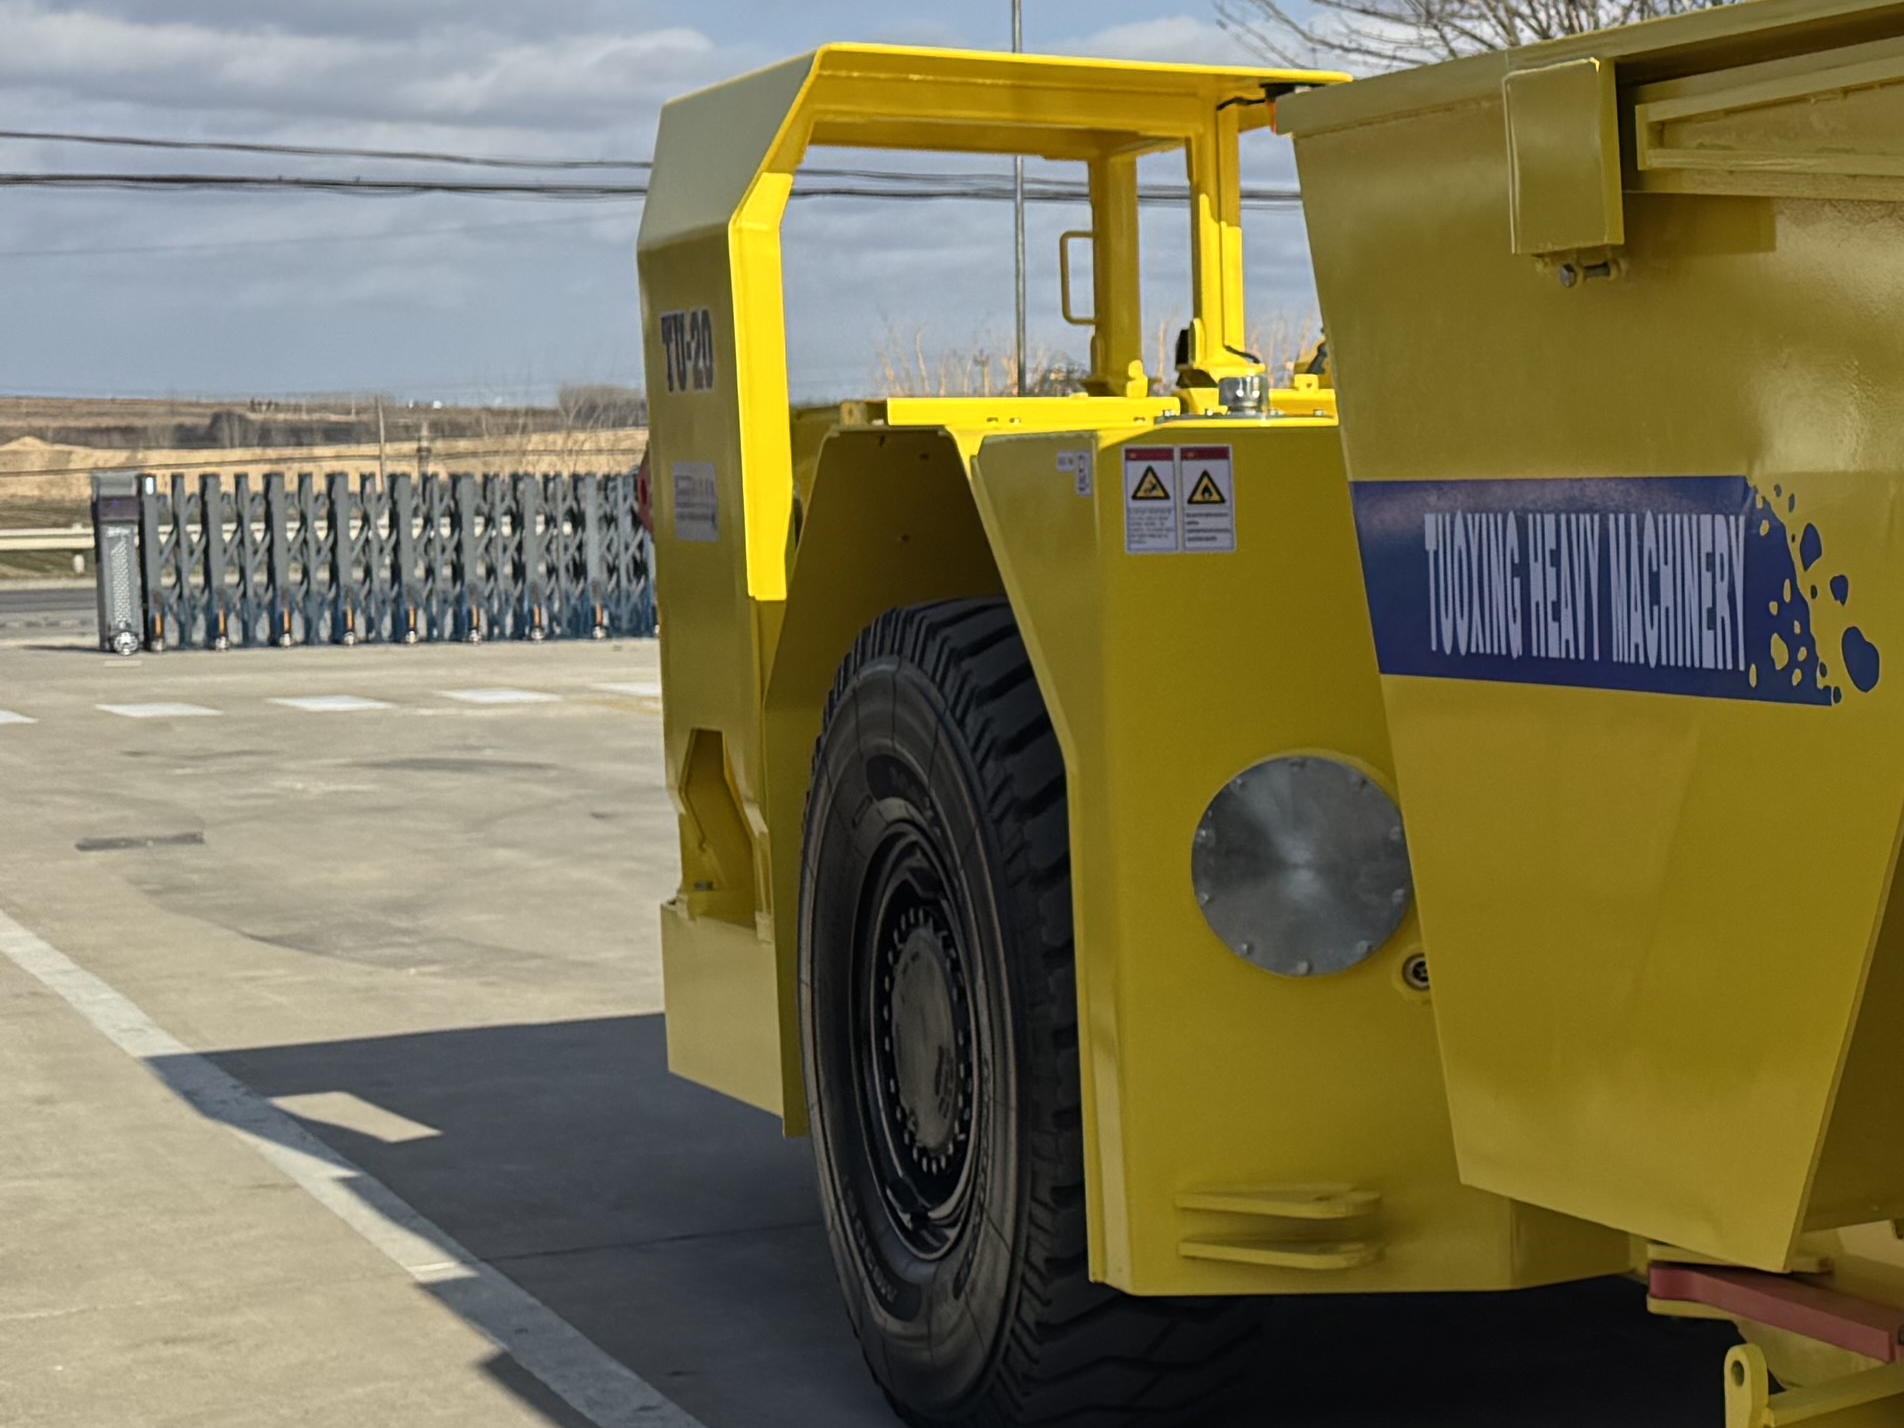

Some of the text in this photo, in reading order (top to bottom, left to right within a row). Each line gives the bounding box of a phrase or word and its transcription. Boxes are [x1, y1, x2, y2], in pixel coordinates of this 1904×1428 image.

[659, 308, 714, 393] TU-20
[1424, 509, 1746, 672] TUOXING HEAVY MACHINERY
